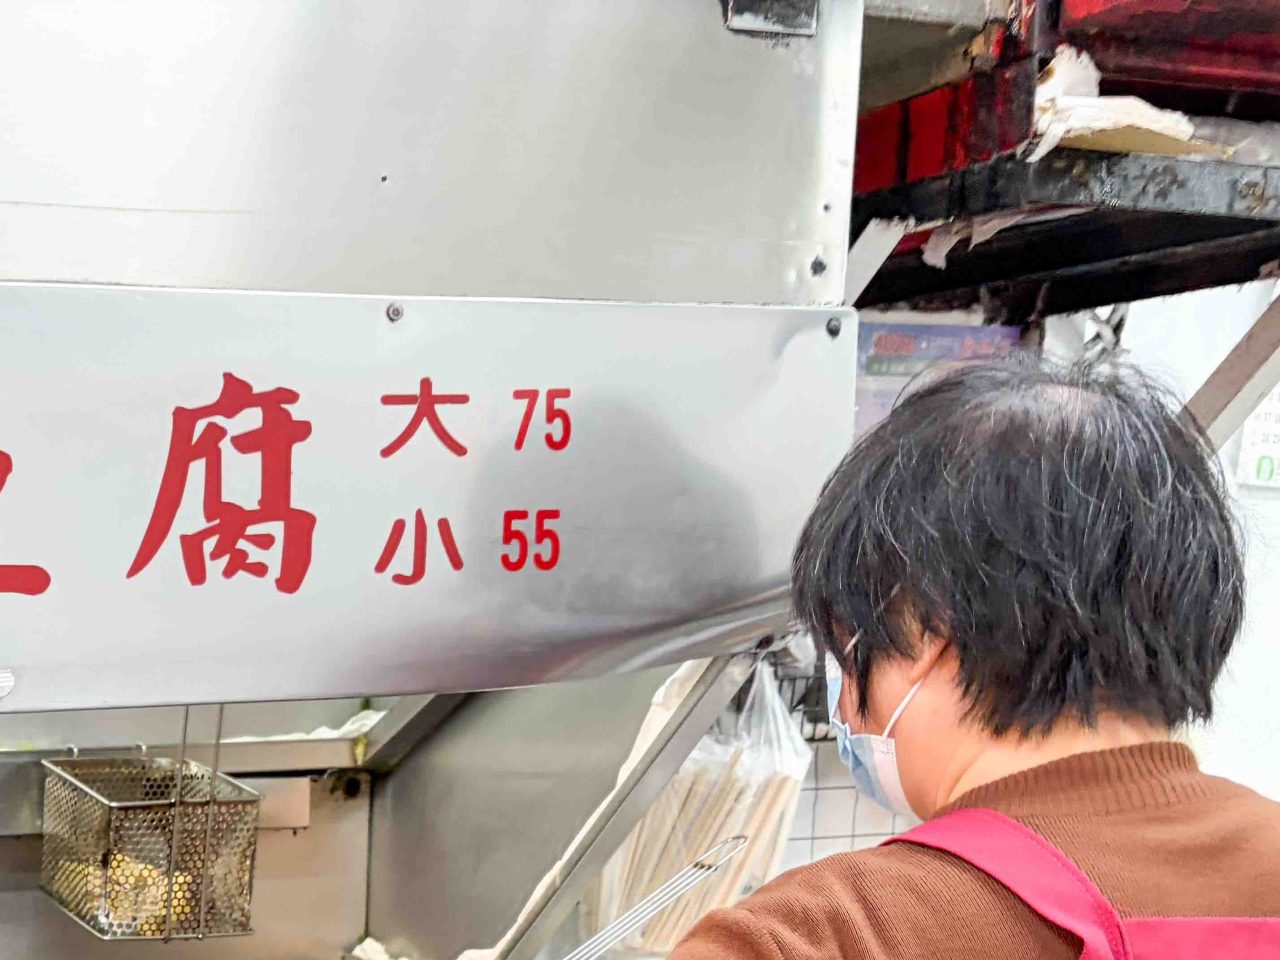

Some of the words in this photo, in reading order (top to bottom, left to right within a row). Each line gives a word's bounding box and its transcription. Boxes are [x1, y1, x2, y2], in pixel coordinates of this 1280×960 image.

[380, 378, 470, 458] 大
[512, 388, 572, 452] 75
[375, 510, 463, 586] 小
[500, 508, 562, 573] 55
